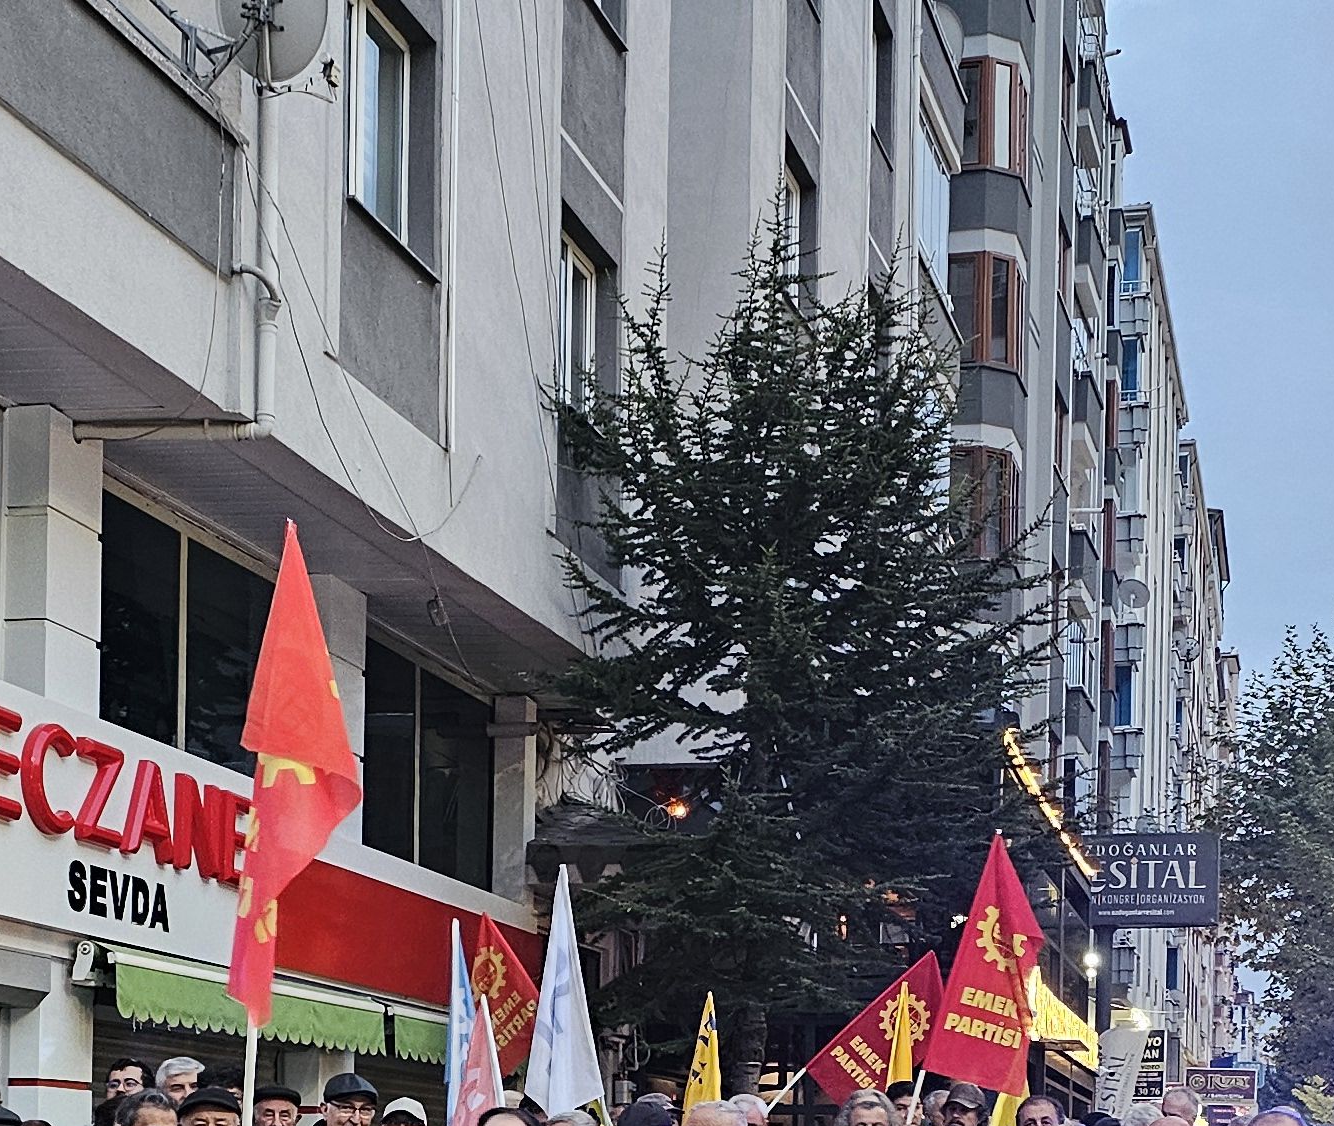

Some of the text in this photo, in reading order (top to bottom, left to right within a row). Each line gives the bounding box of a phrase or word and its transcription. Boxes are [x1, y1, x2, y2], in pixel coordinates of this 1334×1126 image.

[1084, 842, 1197, 856] ZDOĞANLAR
[1091, 857, 1206, 893] ESİTAL
[67, 859, 170, 933] SEVDA
[960, 986, 1019, 1020] EMEK
[943, 1011, 1022, 1049] PARTİSİ
[849, 1035, 888, 1075] EMEK
